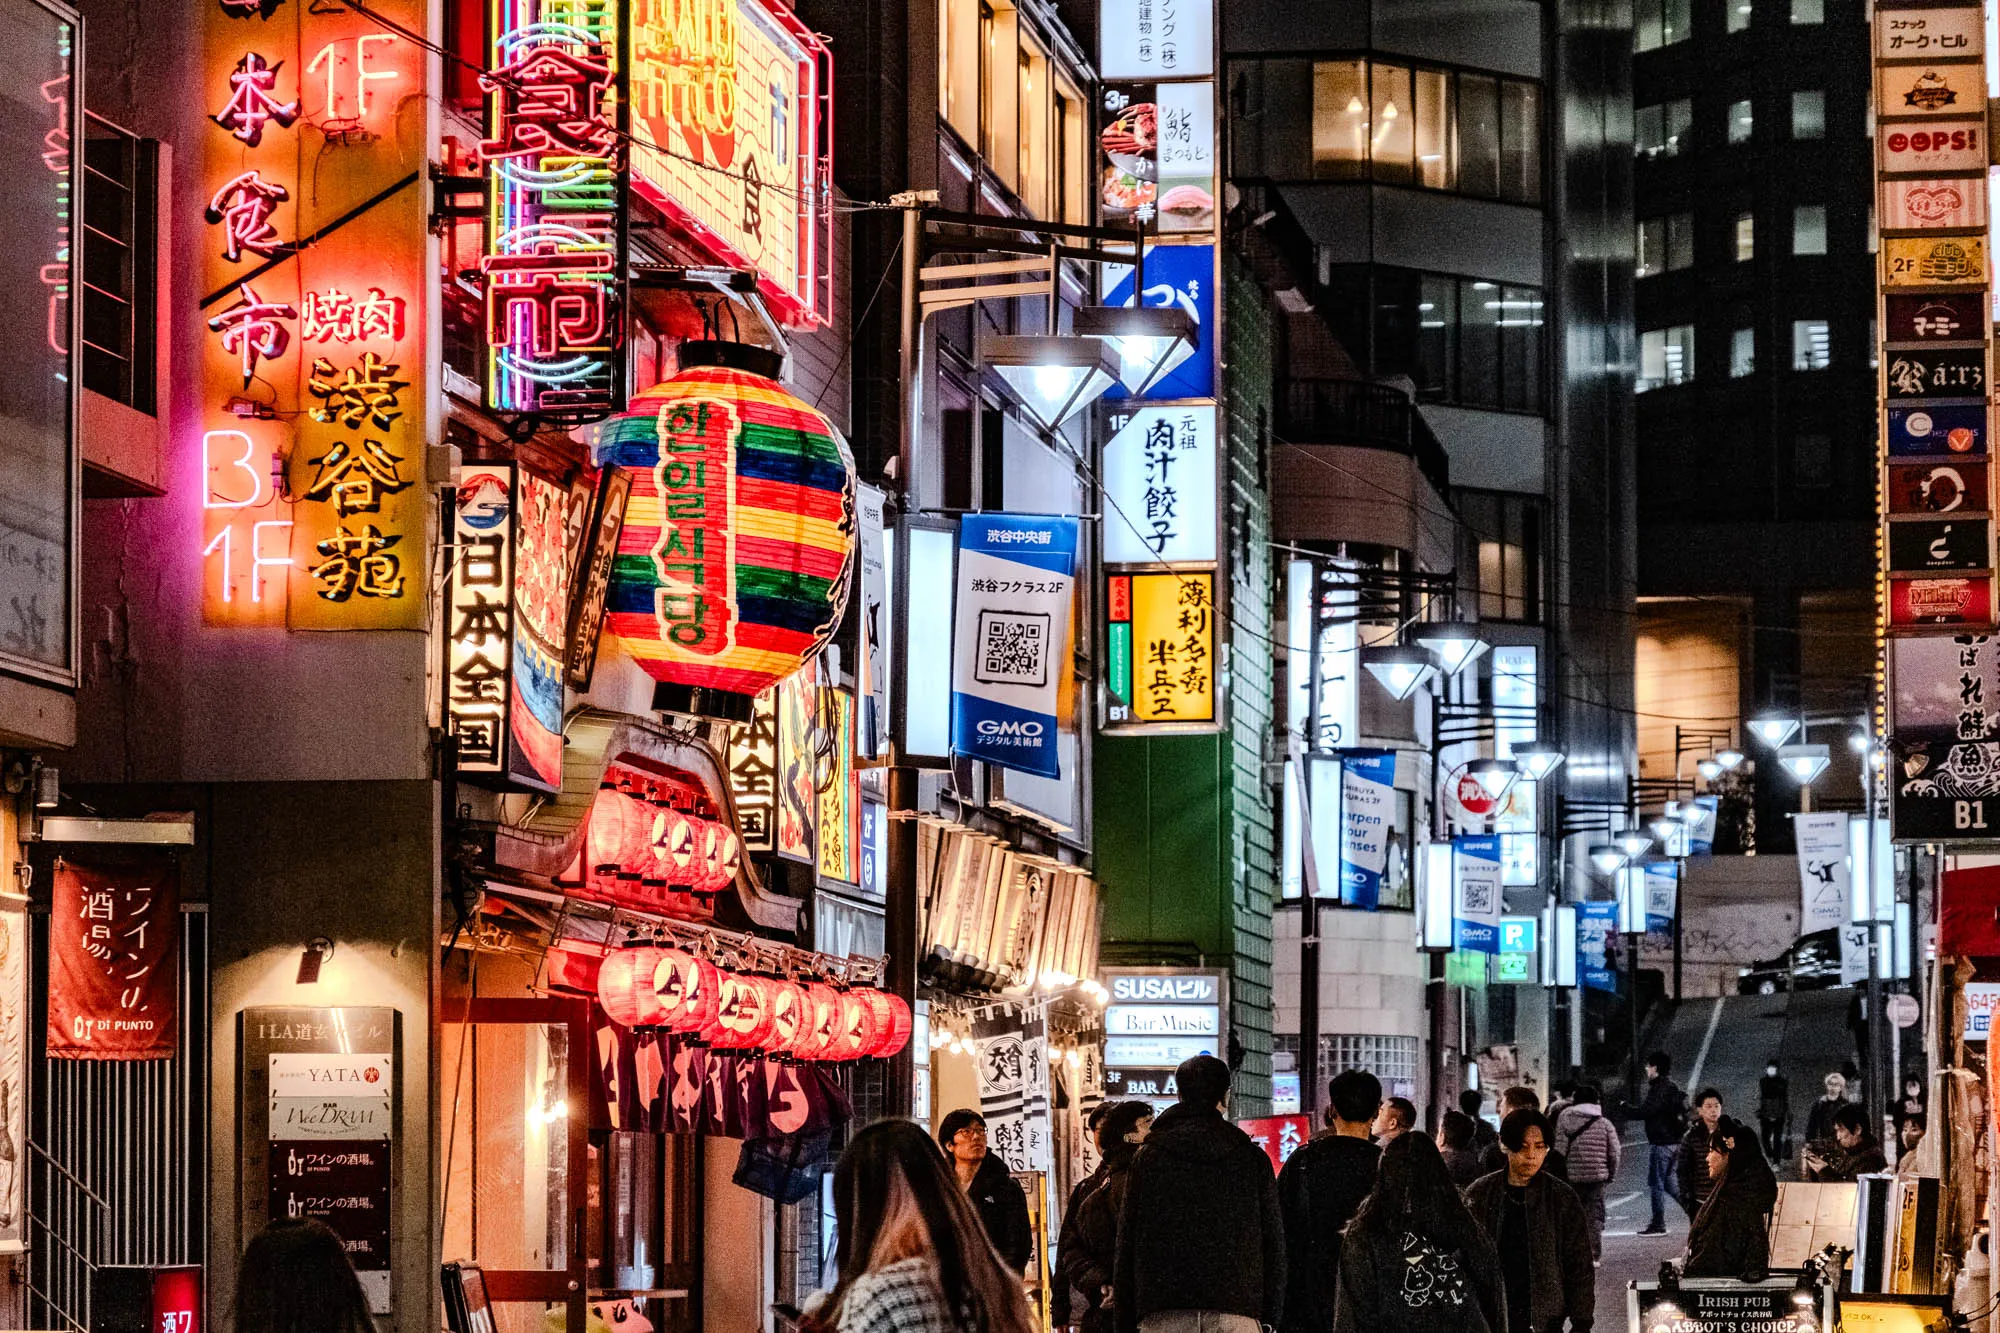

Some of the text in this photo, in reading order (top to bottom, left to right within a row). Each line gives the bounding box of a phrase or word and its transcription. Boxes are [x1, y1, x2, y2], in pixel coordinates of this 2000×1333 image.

[1890, 20, 1926, 30] スナック
[1890, 34, 1968, 48] オーク・ヒル
[307, 34, 399, 118] 1F
[1104, 90, 1130, 111] 3F
[206, 0, 299, 378] 本食市
[477, 46, 615, 356] 食市
[1933, 245, 1963, 258] club
[1894, 258, 1915, 272] 2F
[303, 287, 401, 342] 焼肉
[1913, 317, 1960, 336] マーミー
[1109, 414, 1129, 431] 1F
[1179, 414, 1198, 450] 元祖
[308, 352, 404, 600] 渋谷苑
[1143, 418, 1178, 553] 肉汁餃子
[659, 401, 713, 646] 한일식당
[986, 529, 1052, 545] 渋谷中央街
[203, 521, 294, 602] 1F
[971, 579, 1064, 594] 渋谷フクラス 2F
[451, 534, 511, 765] 日本全国
[1109, 705, 1129, 721] B1
[976, 720, 1043, 736] GMO
[976, 736, 1042, 748] デジタル美術館
[731, 690, 776, 846] 本全国
[1955, 801, 1987, 829] B1
[1345, 827, 1368, 838] our
[1342, 872, 1367, 883] MO
[1505, 924, 1523, 945] P
[1114, 979, 1211, 1000] SUSAビル
[114, 1020, 154, 1031] PUNTO
[1126, 1015, 1213, 1031] Bar Music
[308, 1068, 361, 1082] YATA
[1107, 1071, 1121, 1083] 3F
[1127, 1081, 1159, 1094] BAR
[306, 1153, 374, 1166] ワインの酒場。
[306, 1197, 374, 1209] ワインの酒場。
[1698, 1294, 1771, 1308] IRISH PUB
[1671, 1320, 1797, 1333] ABBOT'S CHOICE
